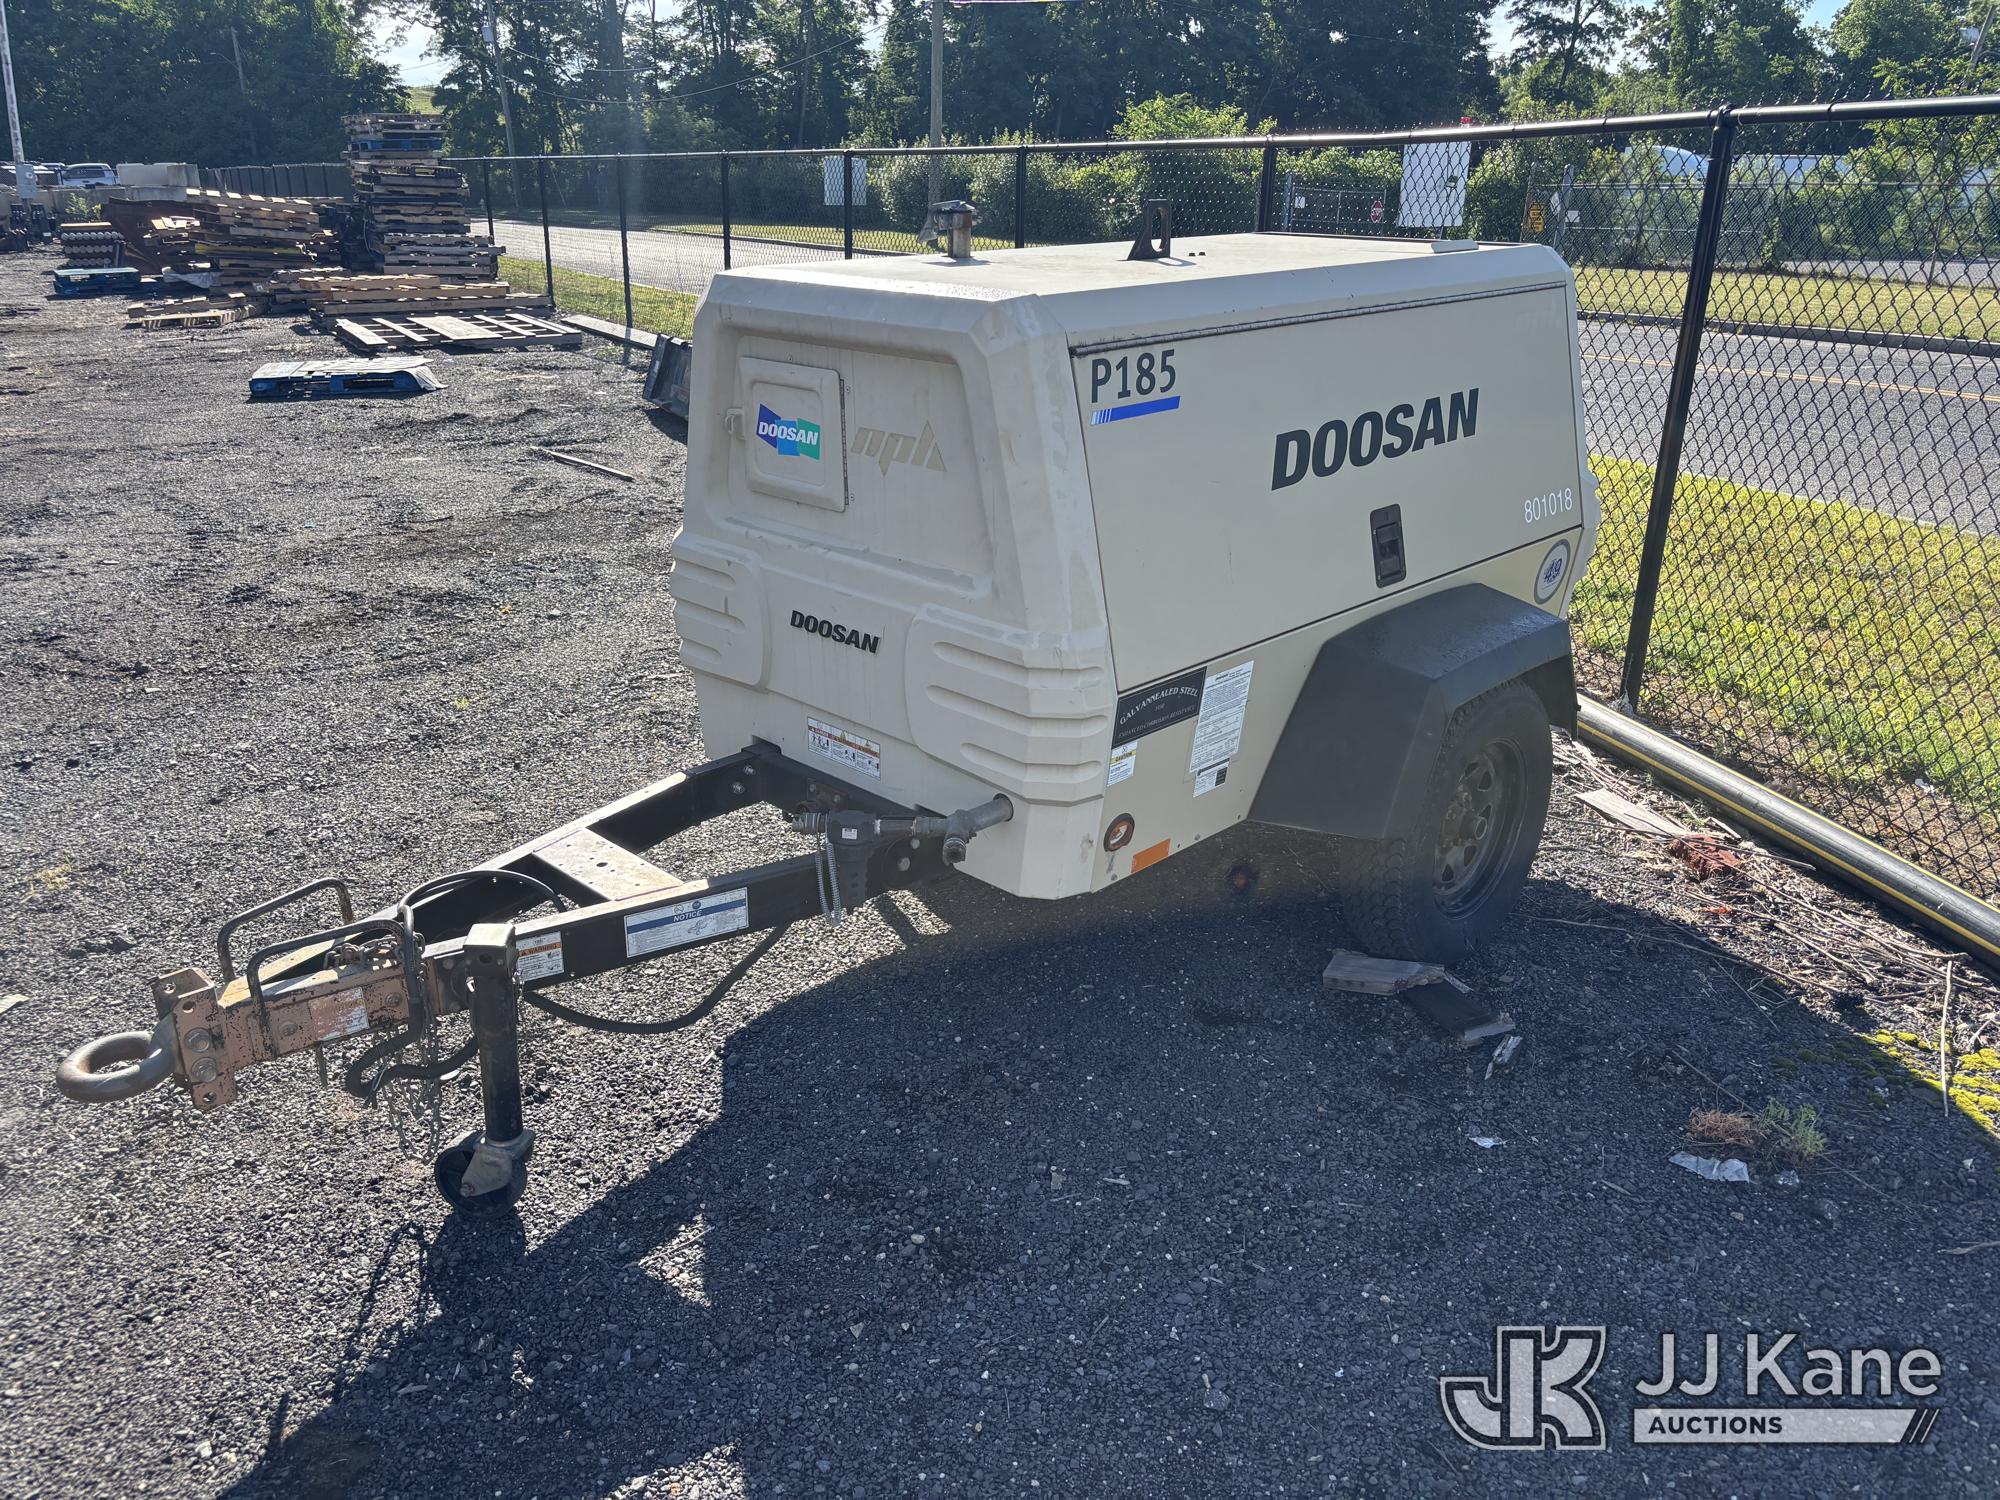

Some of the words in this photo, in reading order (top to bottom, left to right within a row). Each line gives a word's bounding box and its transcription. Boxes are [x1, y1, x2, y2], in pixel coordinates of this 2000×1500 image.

[1091, 349, 1177, 403] P185
[758, 421, 819, 446] DOOSAN
[1272, 387, 1479, 491] DOOSAN
[1524, 487, 1573, 523] 801018
[790, 610, 880, 654] DOOSAN
[1119, 687, 1179, 725] GALVANNEALED
[1180, 686, 1198, 697] STEEL
[673, 909, 703, 922] NOTICE
